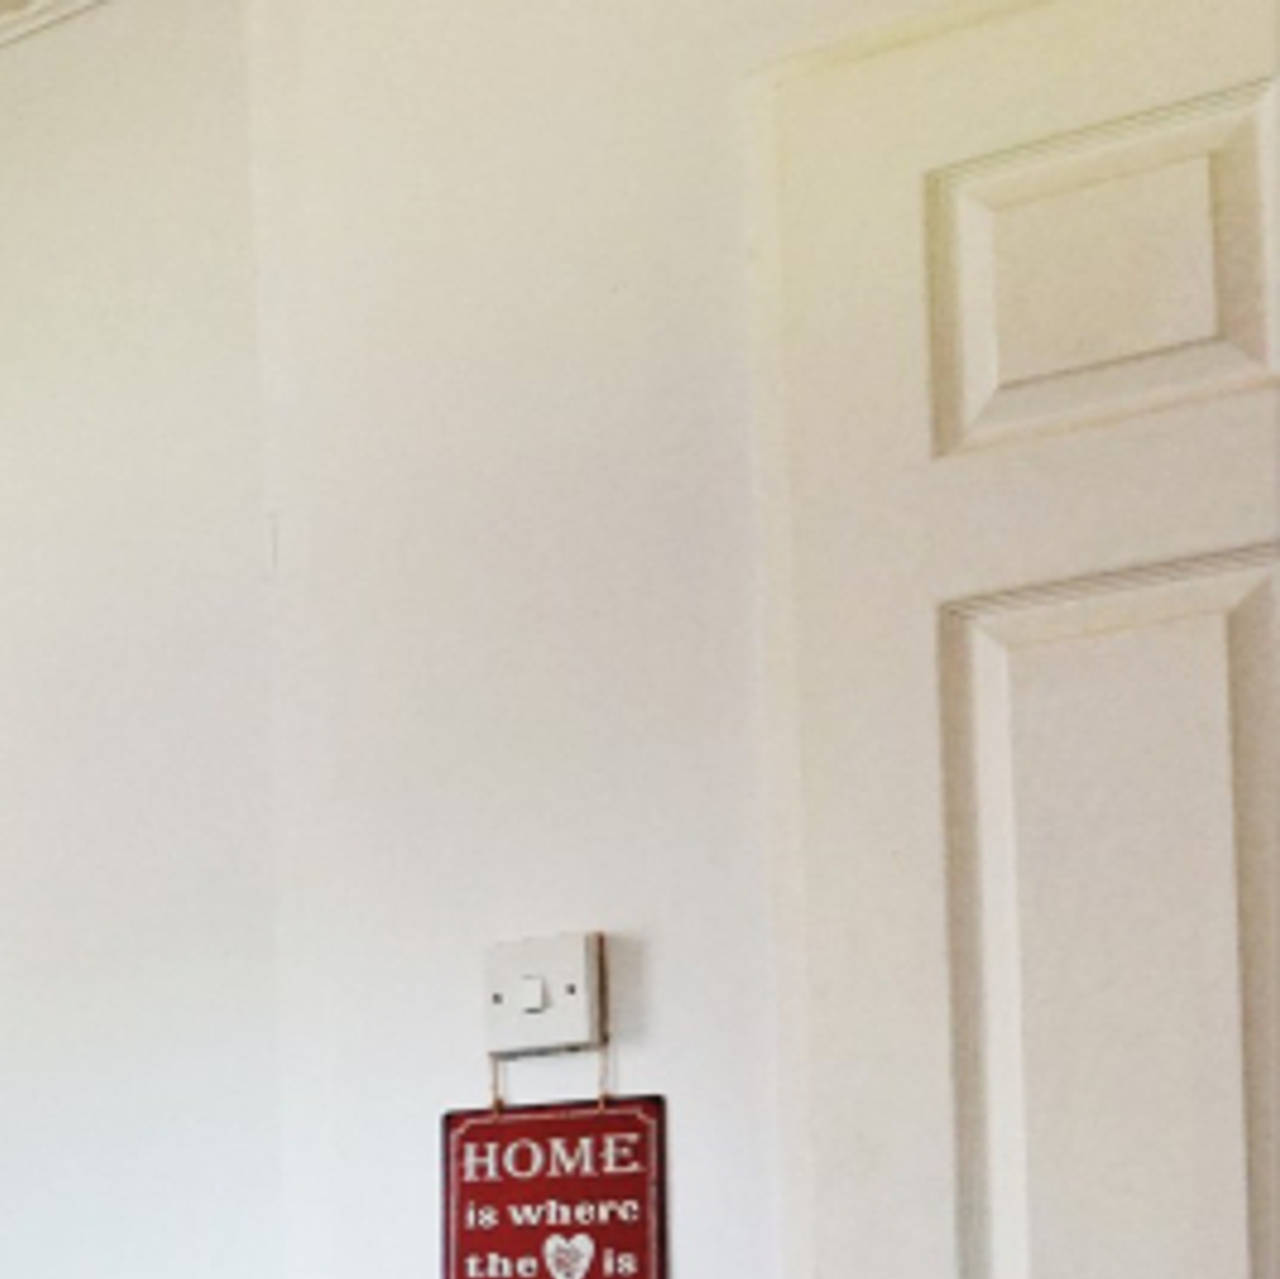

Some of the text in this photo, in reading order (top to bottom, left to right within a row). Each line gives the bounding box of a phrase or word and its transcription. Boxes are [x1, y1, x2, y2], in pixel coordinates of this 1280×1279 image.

[463, 1132, 644, 1182] HOME
[465, 1198, 639, 1230] is where
[465, 1247, 638, 1279] the is
